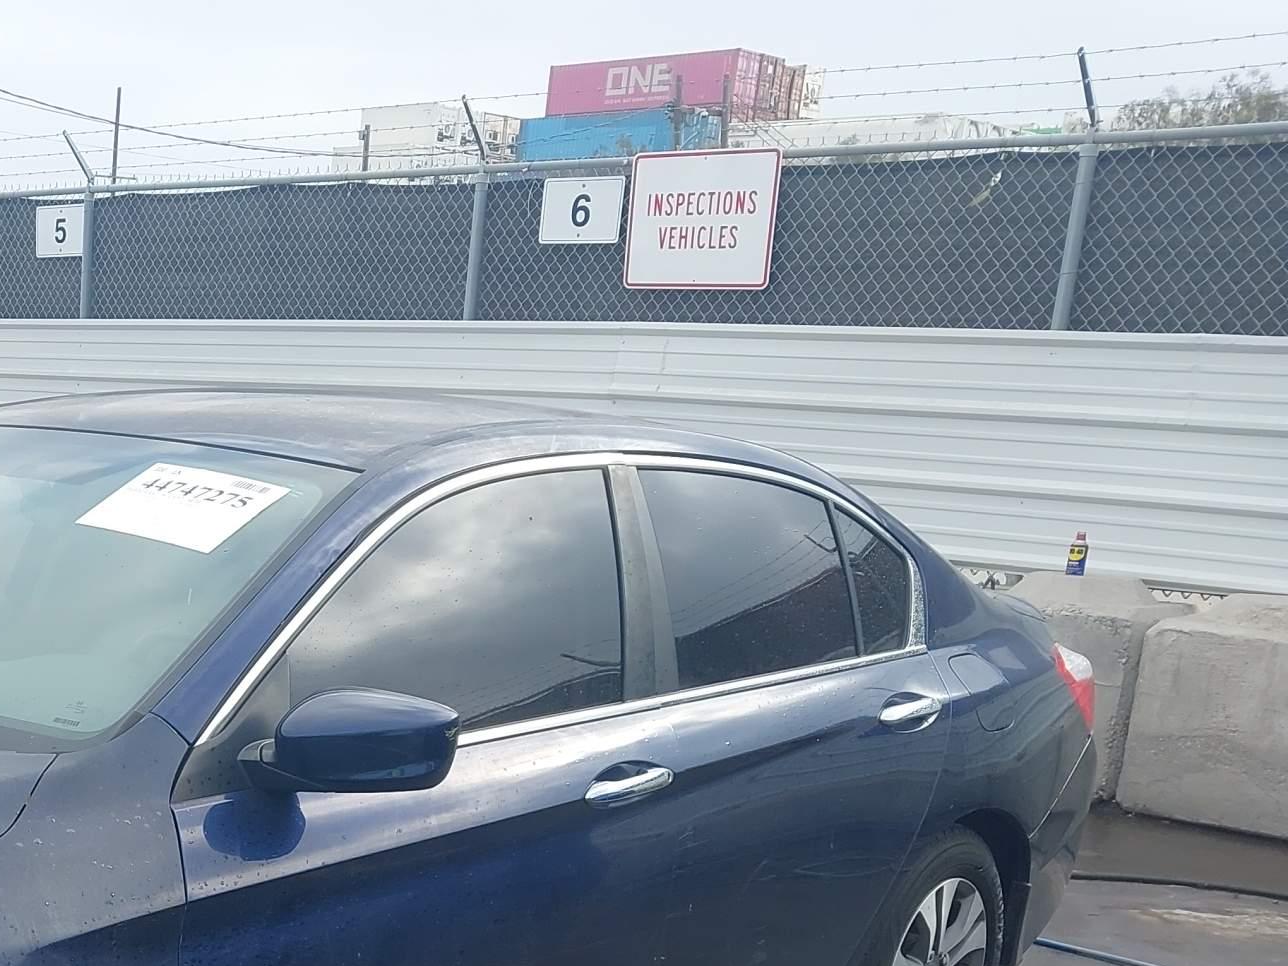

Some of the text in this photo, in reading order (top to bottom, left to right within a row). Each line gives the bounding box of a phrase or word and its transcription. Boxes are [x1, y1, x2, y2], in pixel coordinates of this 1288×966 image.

[605, 63, 670, 97] ONE
[570, 193, 592, 228] 6
[647, 190, 758, 217] INSPECTIONS
[54, 217, 67, 244] 5
[658, 225, 739, 250] VEHICLES
[142, 478, 254, 509] 44747275
